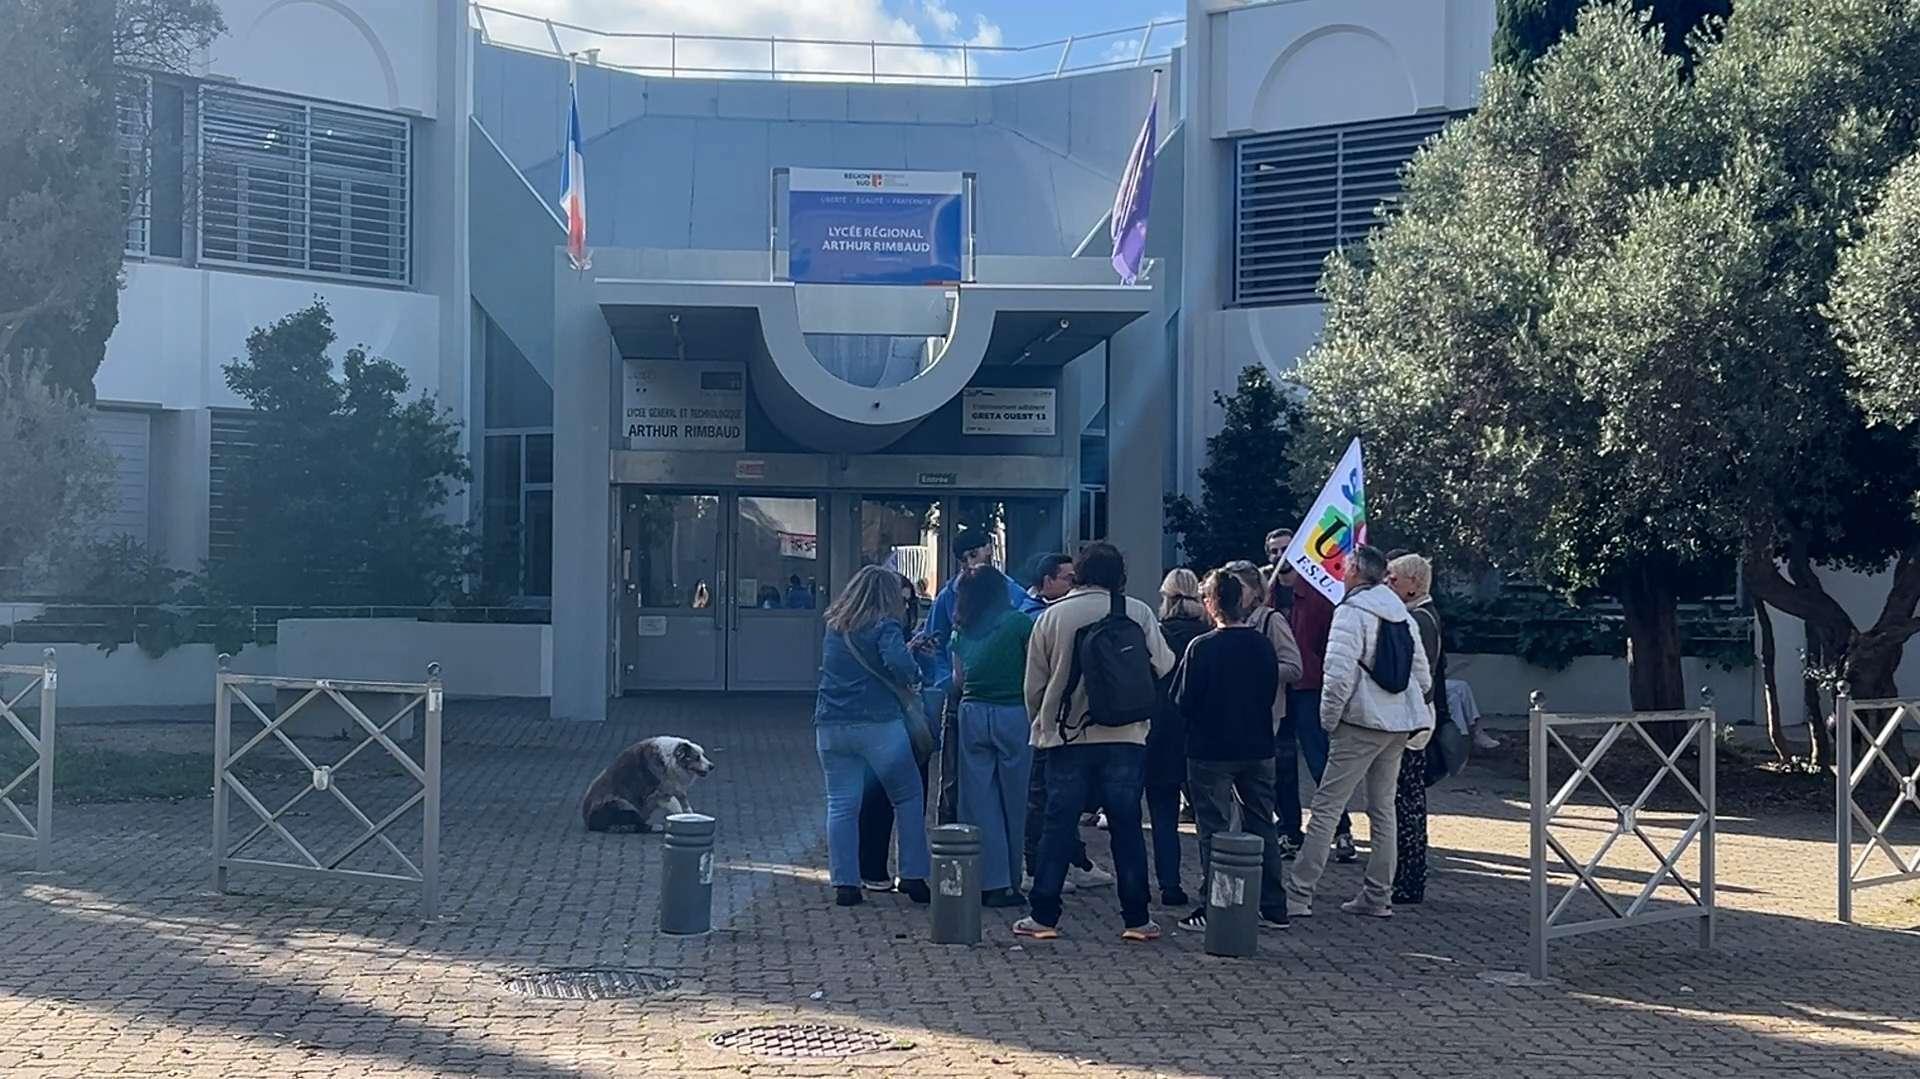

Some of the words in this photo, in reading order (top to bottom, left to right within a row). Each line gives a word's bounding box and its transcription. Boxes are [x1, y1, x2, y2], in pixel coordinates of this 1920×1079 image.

[828, 225, 862, 238] LYCÉE
[864, 226, 924, 239] RÉGIONAL
[822, 240, 871, 252] ARTHUR
[873, 241, 930, 253] RIMBAUD
[971, 412, 1002, 420] GRETA
[1003, 412, 1033, 420] OUEST
[628, 424, 678, 437] ARTHUR
[685, 425, 741, 438] RIMBAUD
[1295, 554, 1334, 593] F.S.U.
